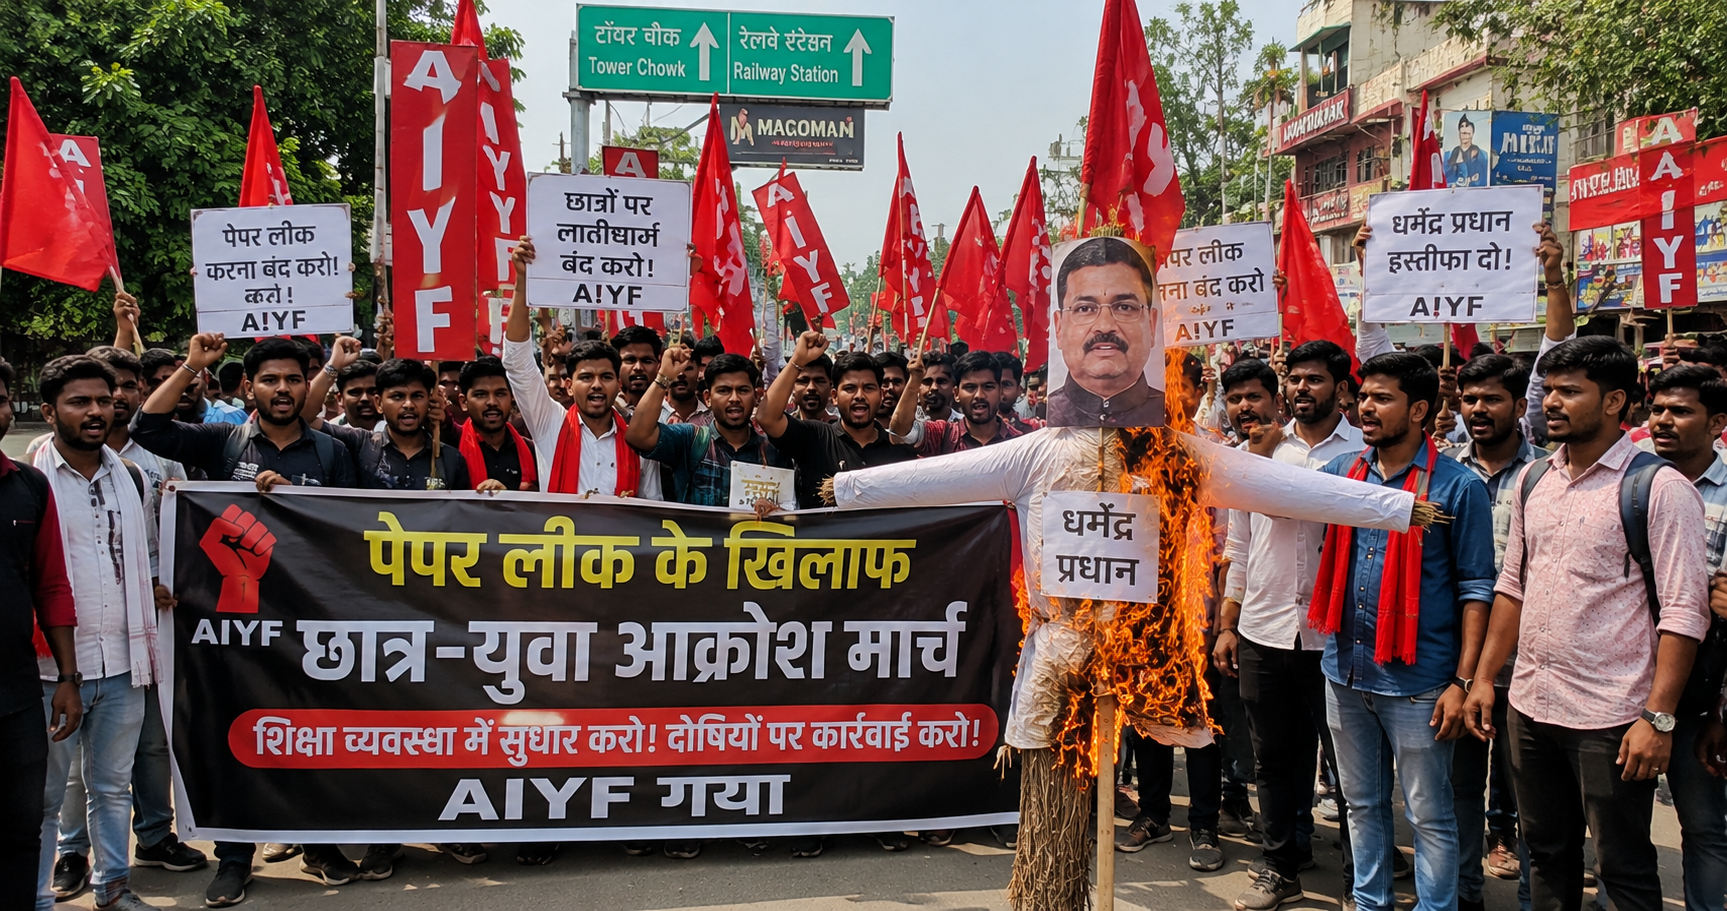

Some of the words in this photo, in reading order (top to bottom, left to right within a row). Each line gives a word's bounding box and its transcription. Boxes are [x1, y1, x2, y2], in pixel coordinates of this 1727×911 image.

[739, 25, 779, 50] रेलवे
[588, 56, 632, 75] Tower
[637, 58, 686, 77] Chowk
[734, 61, 786, 85] Railway
[791, 64, 838, 83] Station
[403, 50, 462, 353] AIYF
[623, 195, 653, 216] पर
[222, 223, 262, 247] पेपर
[267, 220, 316, 245] लीक
[1450, 211, 1513, 233] प्रधान
[205, 261, 257, 281] करना
[262, 255, 291, 278] बंद
[295, 251, 339, 277] करो!
[560, 250, 595, 275] बंद
[600, 252, 653, 278] करो!
[1164, 248, 1193, 268] पर
[1198, 239, 1244, 265] लीक
[1388, 243, 1472, 274] इस्तीफा
[1477, 241, 1512, 271] दो!
[1226, 267, 1264, 294] करो
[363, 511, 487, 587] पेपर
[498, 515, 639, 589] लीक
[651, 519, 712, 590] के
[724, 520, 917, 591] खिलाफ
[1056, 555, 1139, 586] प्रधान
[191, 619, 283, 646] AIYF
[296, 620, 597, 705] छात्र-युवा
[615, 601, 832, 683] आक्रोश
[843, 600, 968, 679] मार्च
[253, 716, 337, 757] शिक्षा
[464, 717, 496, 755] में
[498, 725, 581, 766] सुधार
[588, 715, 656, 754] करो!
[666, 713, 764, 753] दोषियों
[766, 722, 805, 750] पर
[810, 712, 912, 752] कार्रवाई
[918, 711, 980, 748] करो!
[438, 776, 634, 821] AIYF
[657, 774, 791, 817] गया
